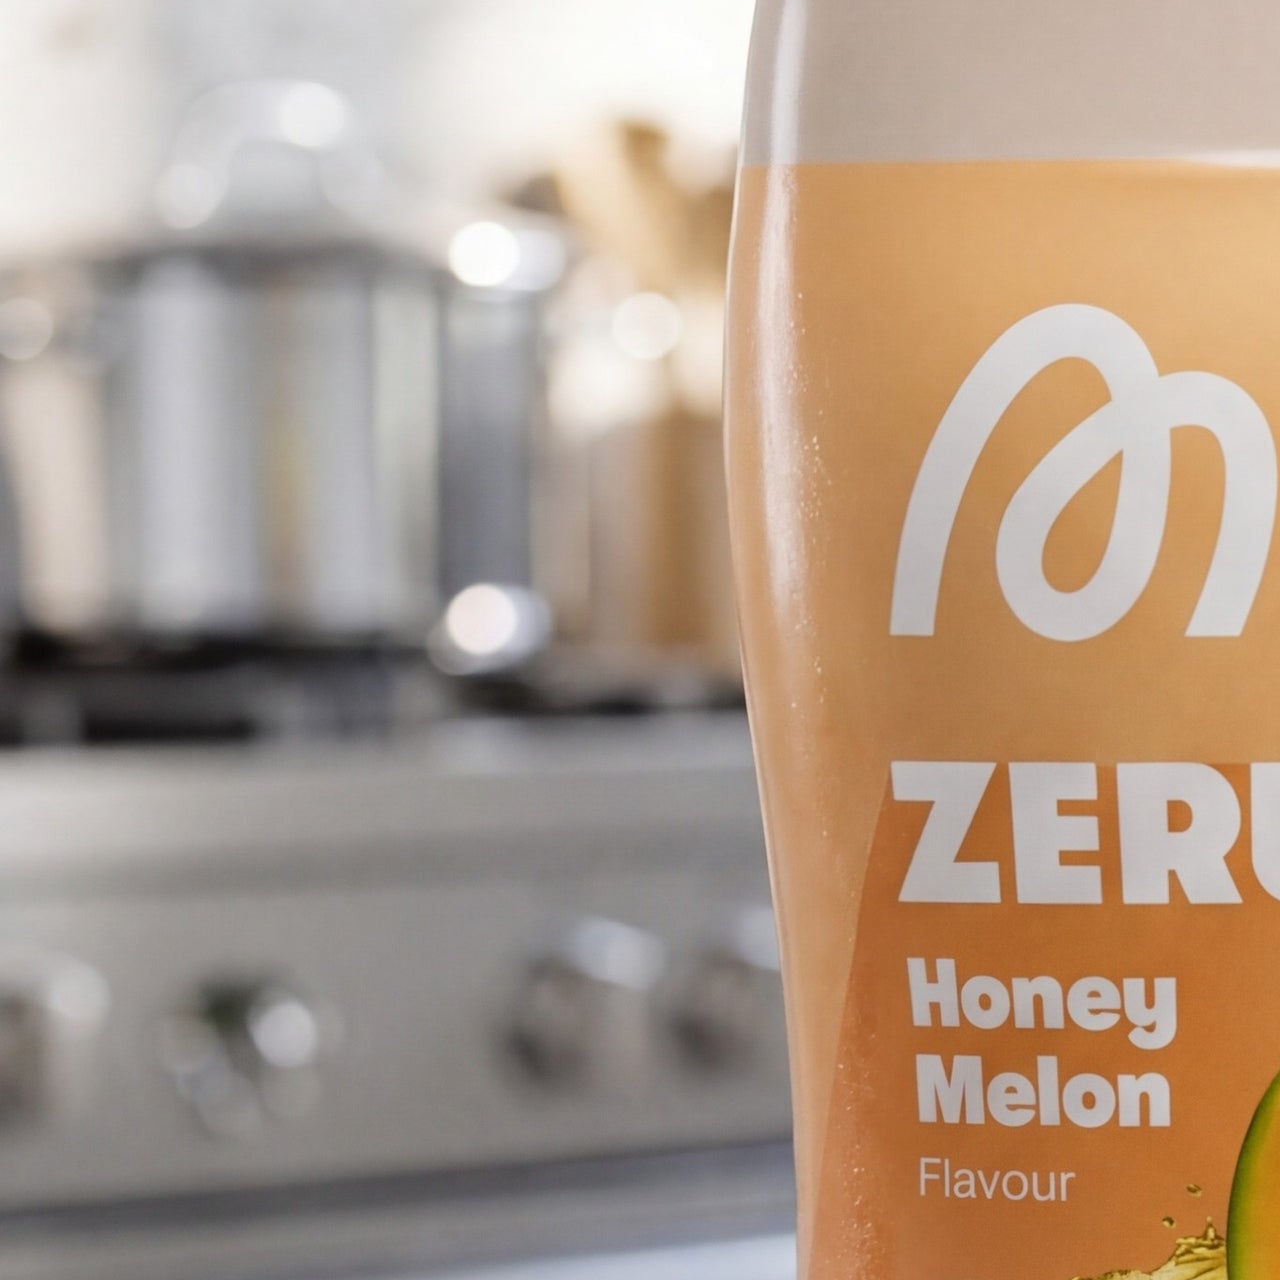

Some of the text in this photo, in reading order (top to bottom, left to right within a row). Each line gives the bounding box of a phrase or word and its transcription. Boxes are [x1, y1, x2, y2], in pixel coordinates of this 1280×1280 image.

[906, 957, 1178, 1050] Honey
[915, 1053, 1172, 1129] Melon
[918, 1156, 1077, 1203] Flavour
